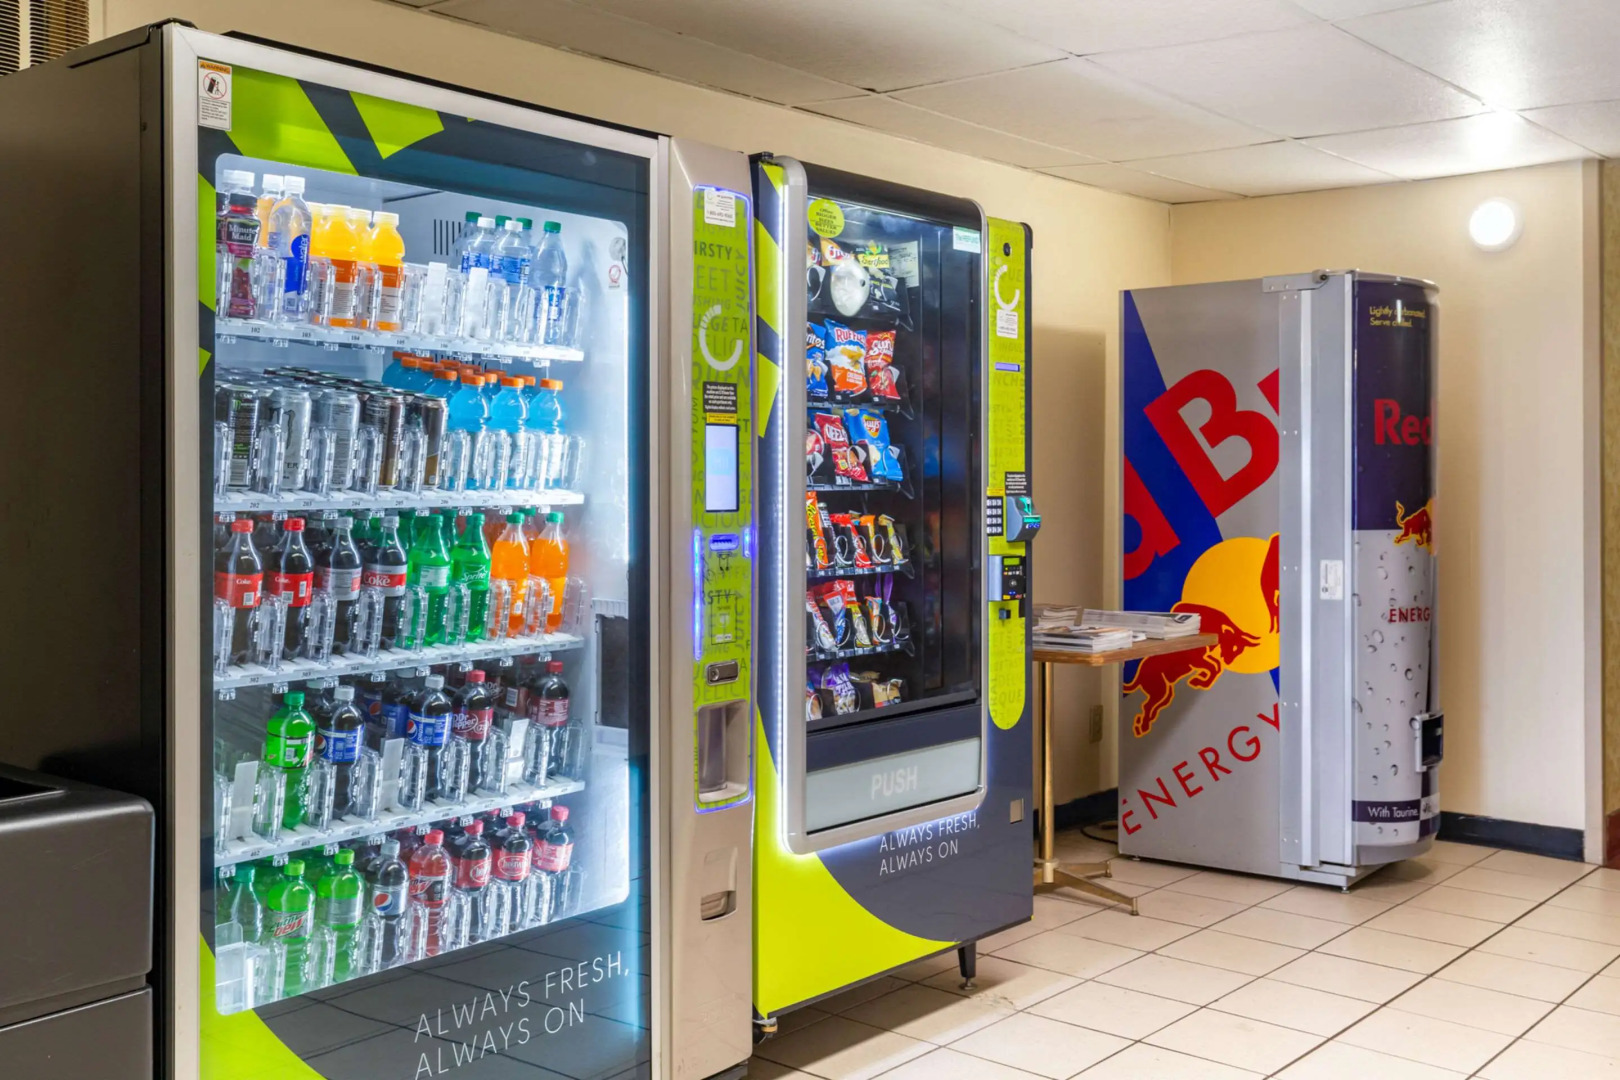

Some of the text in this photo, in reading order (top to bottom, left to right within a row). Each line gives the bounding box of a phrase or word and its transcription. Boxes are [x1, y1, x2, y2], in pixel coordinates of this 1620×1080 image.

[229, 224, 257, 235] Minute
[231, 232, 252, 241] Maid
[1370, 316, 1391, 327] Serve
[363, 571, 391, 587] Coke
[462, 570, 487, 582] Sprite
[871, 766, 918, 800] PUSH
[1367, 804, 1391, 818] With
[880, 812, 980, 853] ALWAYS FRESH,
[880, 839, 959, 876] ALWAYS ON
[415, 950, 629, 1043] ALWAYS FRESH,
[415, 998, 584, 1080] ALWAYS ON
